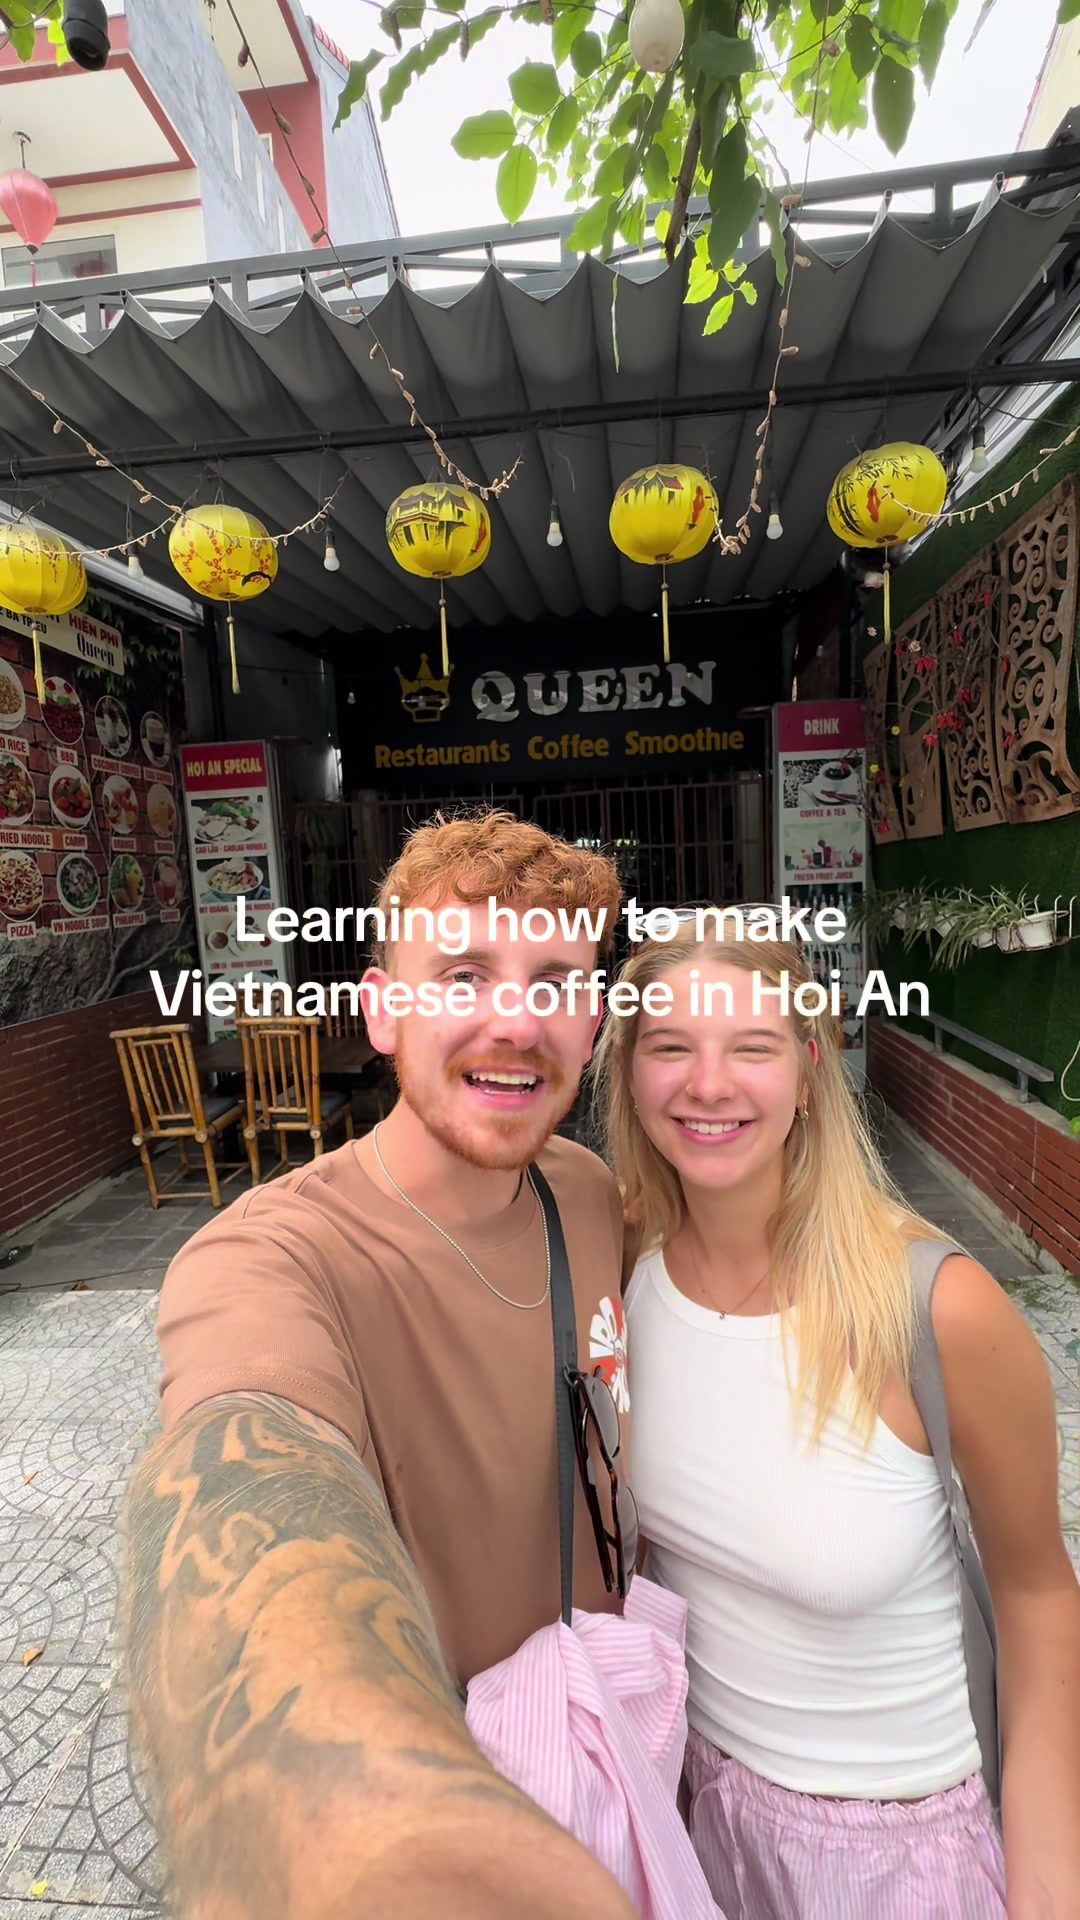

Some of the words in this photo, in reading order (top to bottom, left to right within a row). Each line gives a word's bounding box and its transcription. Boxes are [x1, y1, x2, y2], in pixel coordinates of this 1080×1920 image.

[21, 614, 47, 634] TREU
[100, 628, 119, 648] PHI
[76, 633, 115, 666] Queen
[471, 660, 717, 722] QUEEN
[804, 718, 840, 736] DRINK
[8, 739, 26, 753] RICE
[375, 738, 511, 768] Restaurants
[527, 733, 610, 761] Coffee
[625, 727, 744, 756] Smoothie
[186, 761, 205, 777] HOI
[208, 760, 222, 776] AN
[224, 757, 262, 775] SPECIAL
[800, 809, 824, 818] COFFEE
[834, 808, 846, 816] TEA
[21, 833, 51, 845] NOODLE
[10, 925, 34, 938] PIZZA
[53, 921, 64, 933] VN
[65, 919, 90, 932] NOODLE
[91, 917, 108, 929] SOUP
